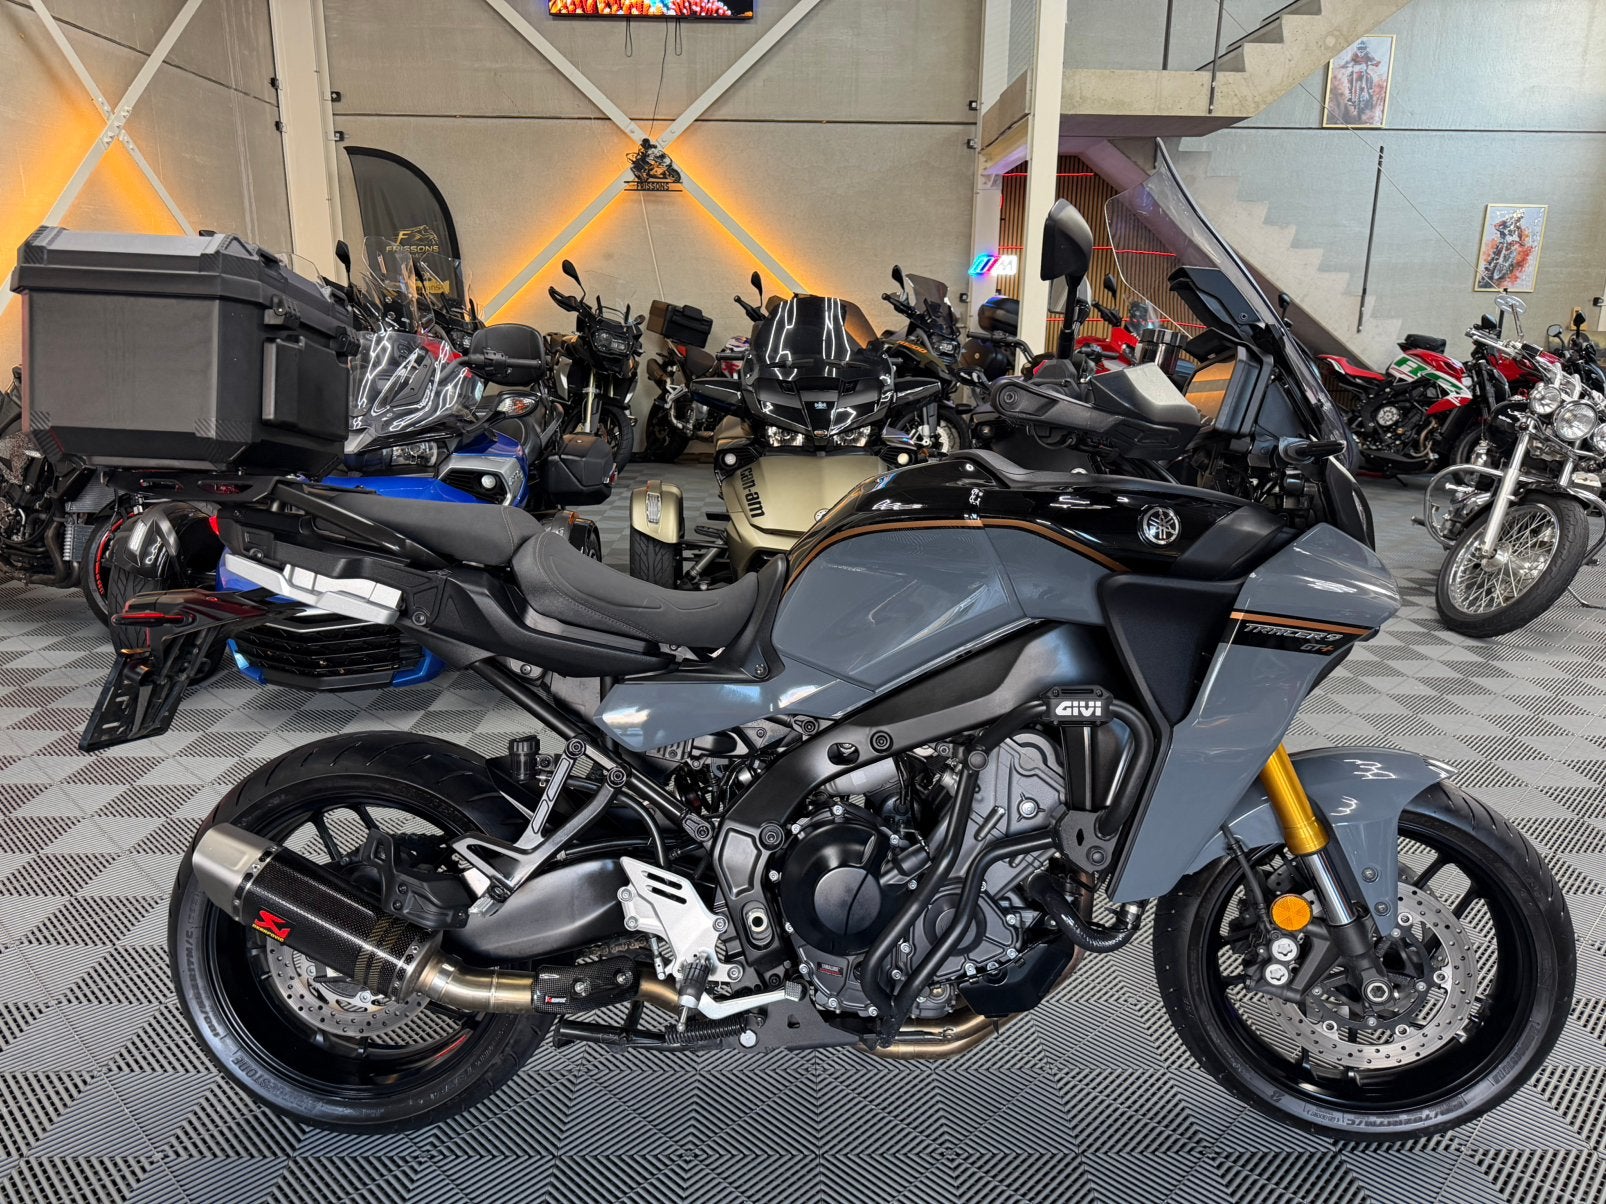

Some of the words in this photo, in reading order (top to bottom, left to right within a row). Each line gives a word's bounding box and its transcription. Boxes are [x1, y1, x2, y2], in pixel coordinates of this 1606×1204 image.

[636, 182, 670, 191] FRISSONS
[386, 245, 440, 253] FRISSONS
[1055, 701, 1102, 717] GIVI
